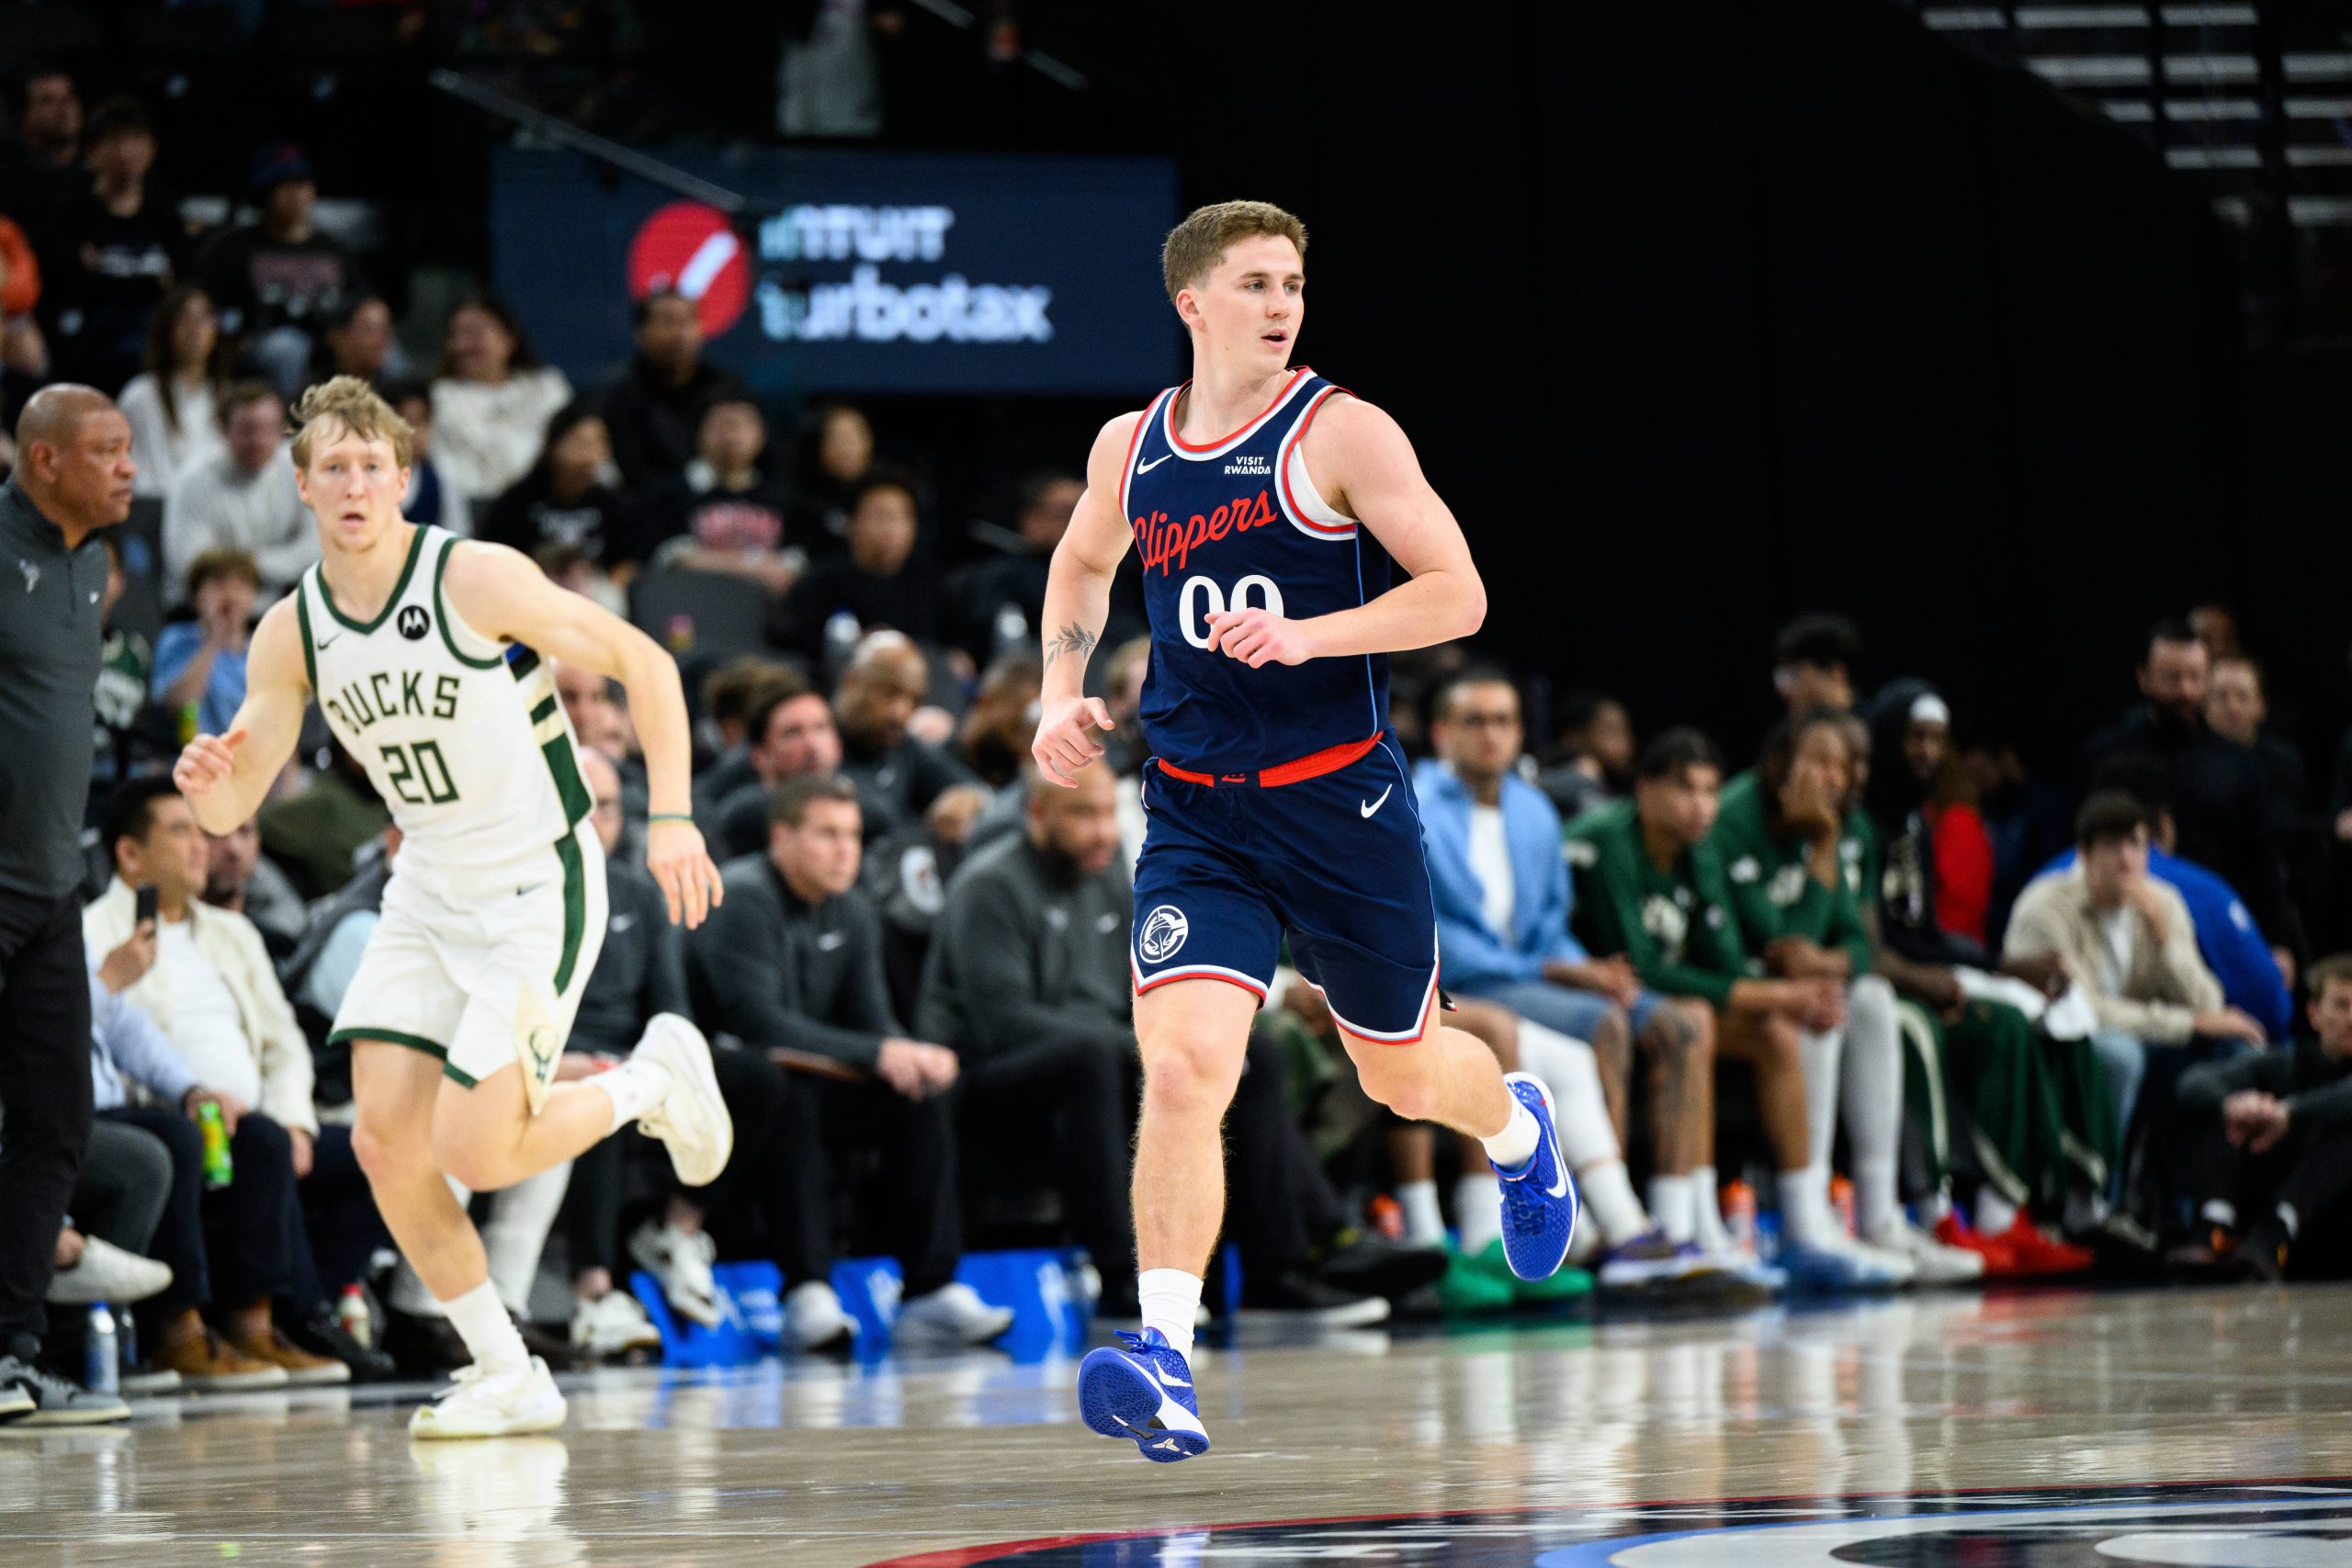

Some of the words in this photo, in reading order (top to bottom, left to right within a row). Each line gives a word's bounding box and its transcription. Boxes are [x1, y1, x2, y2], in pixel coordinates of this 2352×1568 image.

[1224, 465, 1272, 475] RWANDA
[1236, 456, 1264, 466] VISIT
[1134, 490, 1278, 577] Clippers
[379, 739, 459, 805] 20
